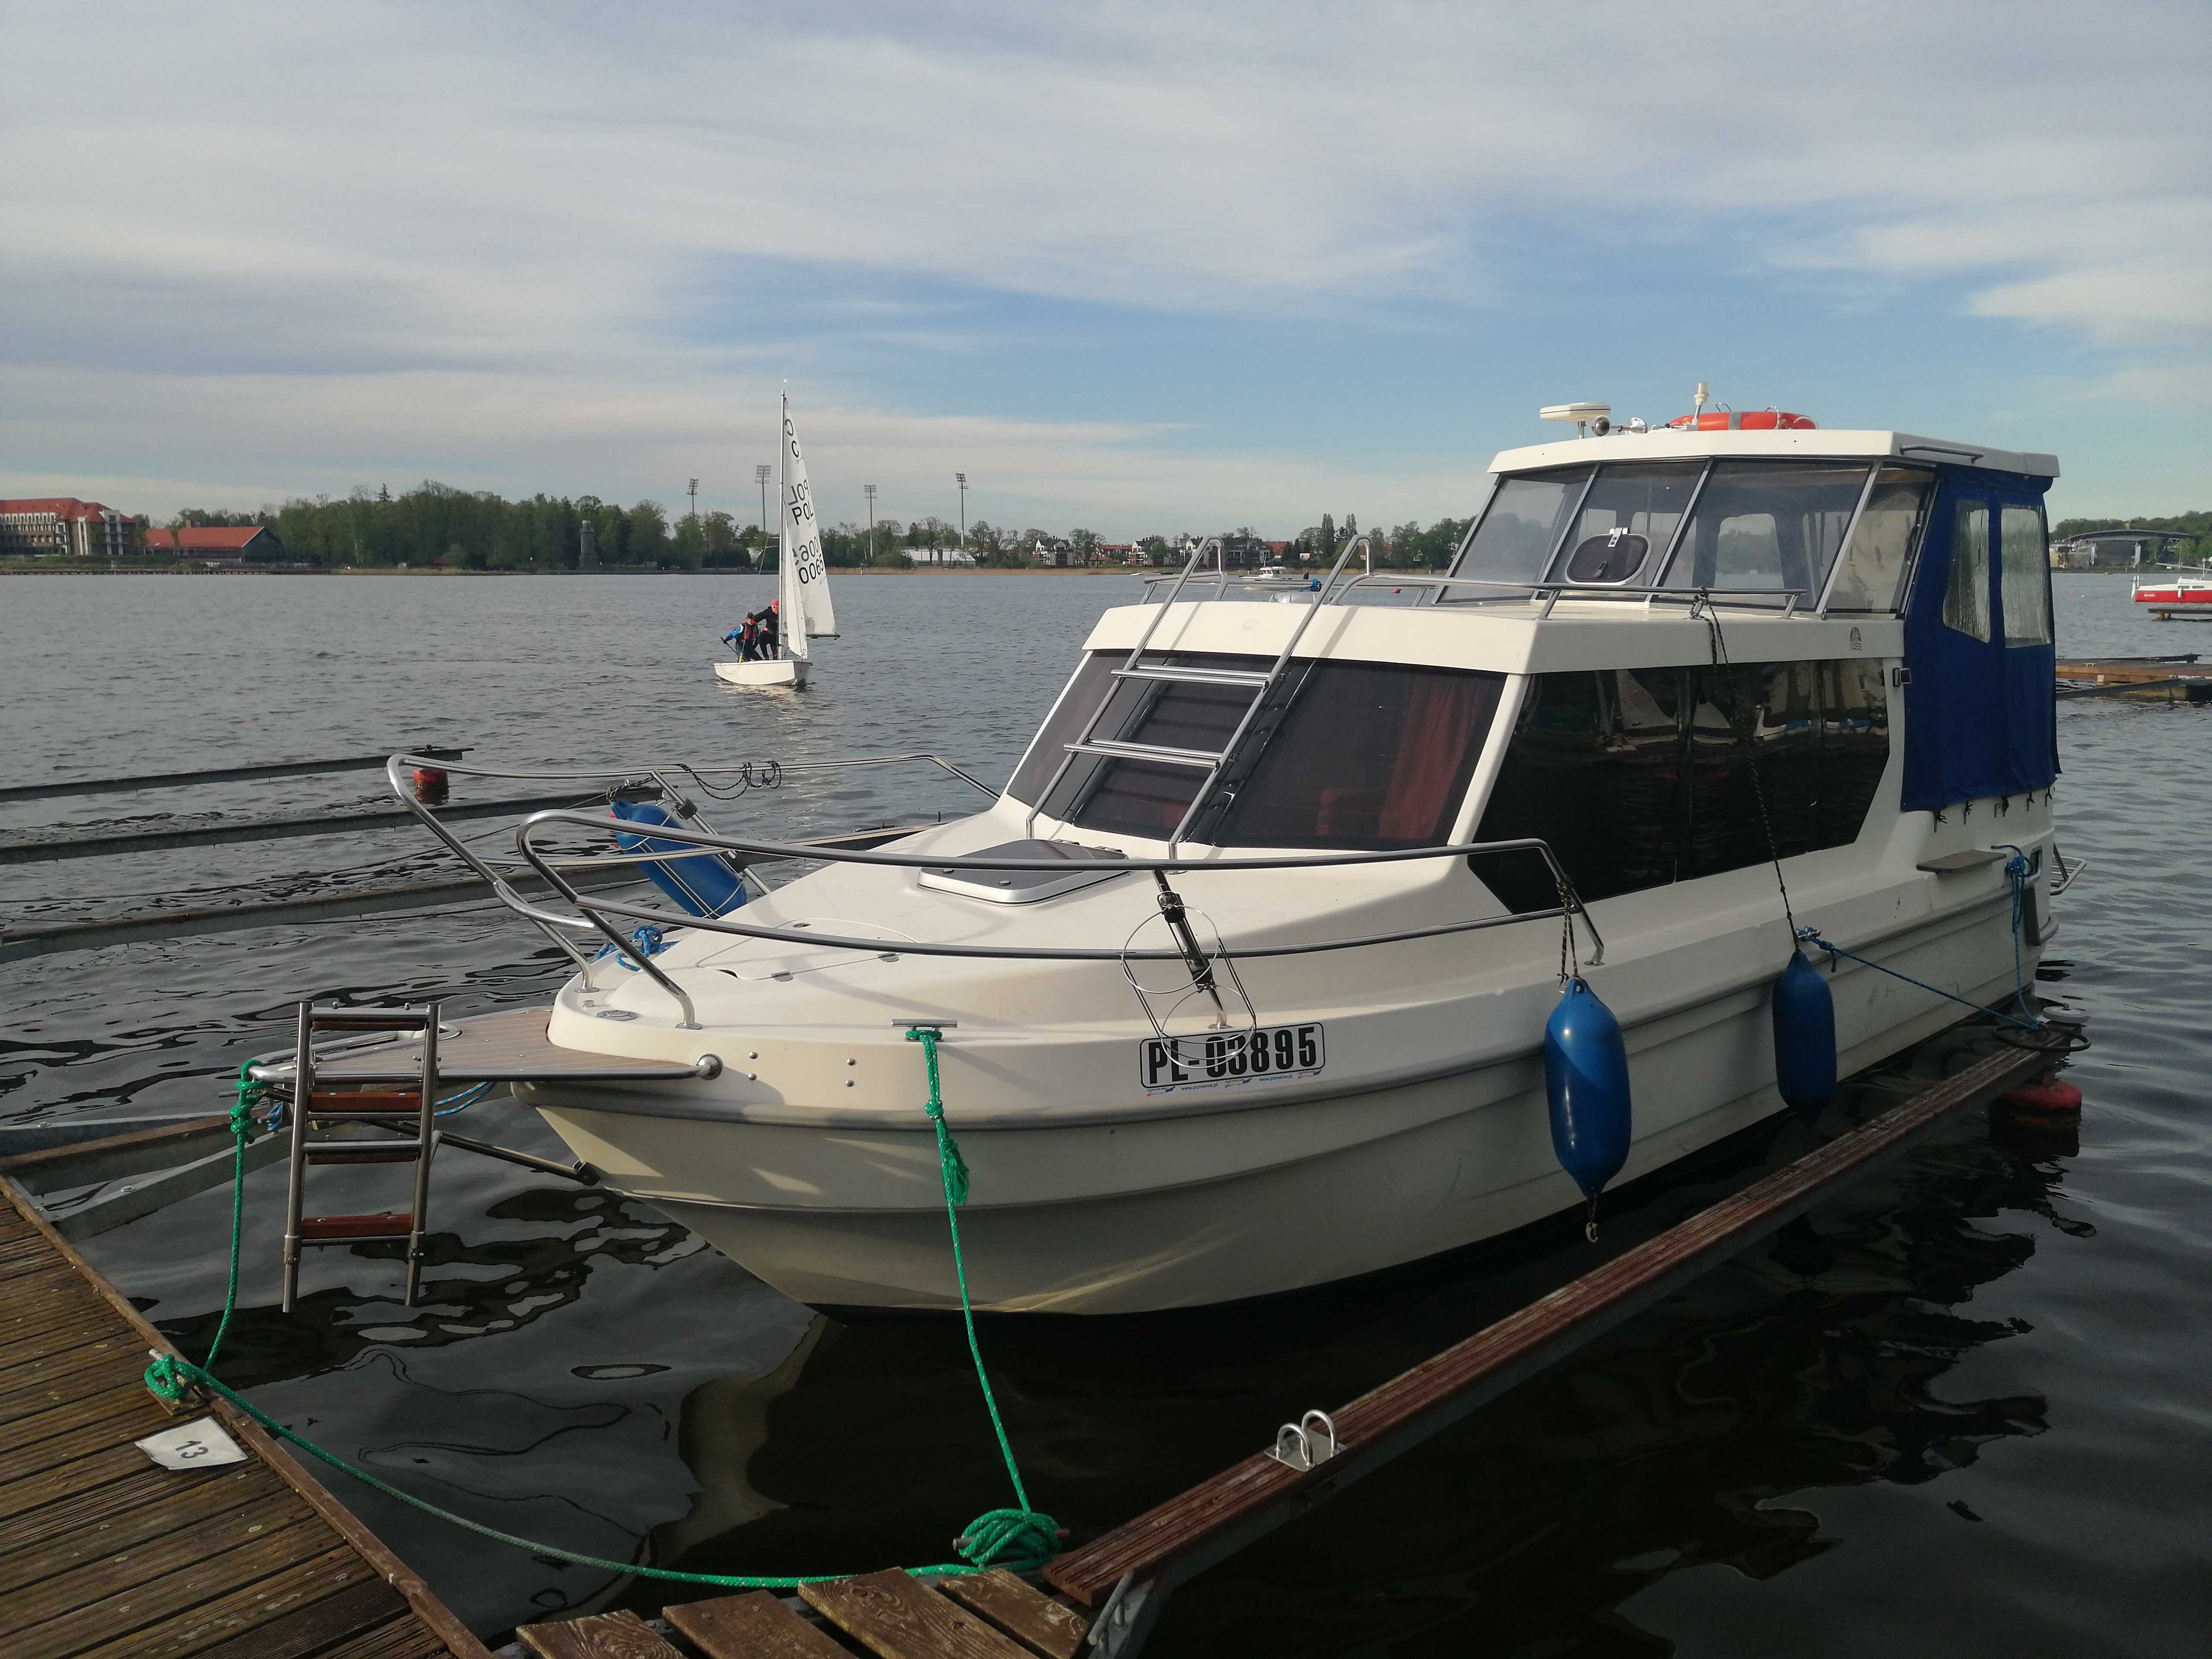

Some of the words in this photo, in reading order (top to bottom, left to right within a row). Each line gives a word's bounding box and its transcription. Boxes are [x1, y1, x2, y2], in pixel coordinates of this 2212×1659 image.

[791, 440, 799, 458] C
[791, 500, 814, 525] POL
[798, 553, 824, 584] 0065
[1148, 1027, 1316, 1084] PL-03895
[175, 1440, 208, 1459] 13
